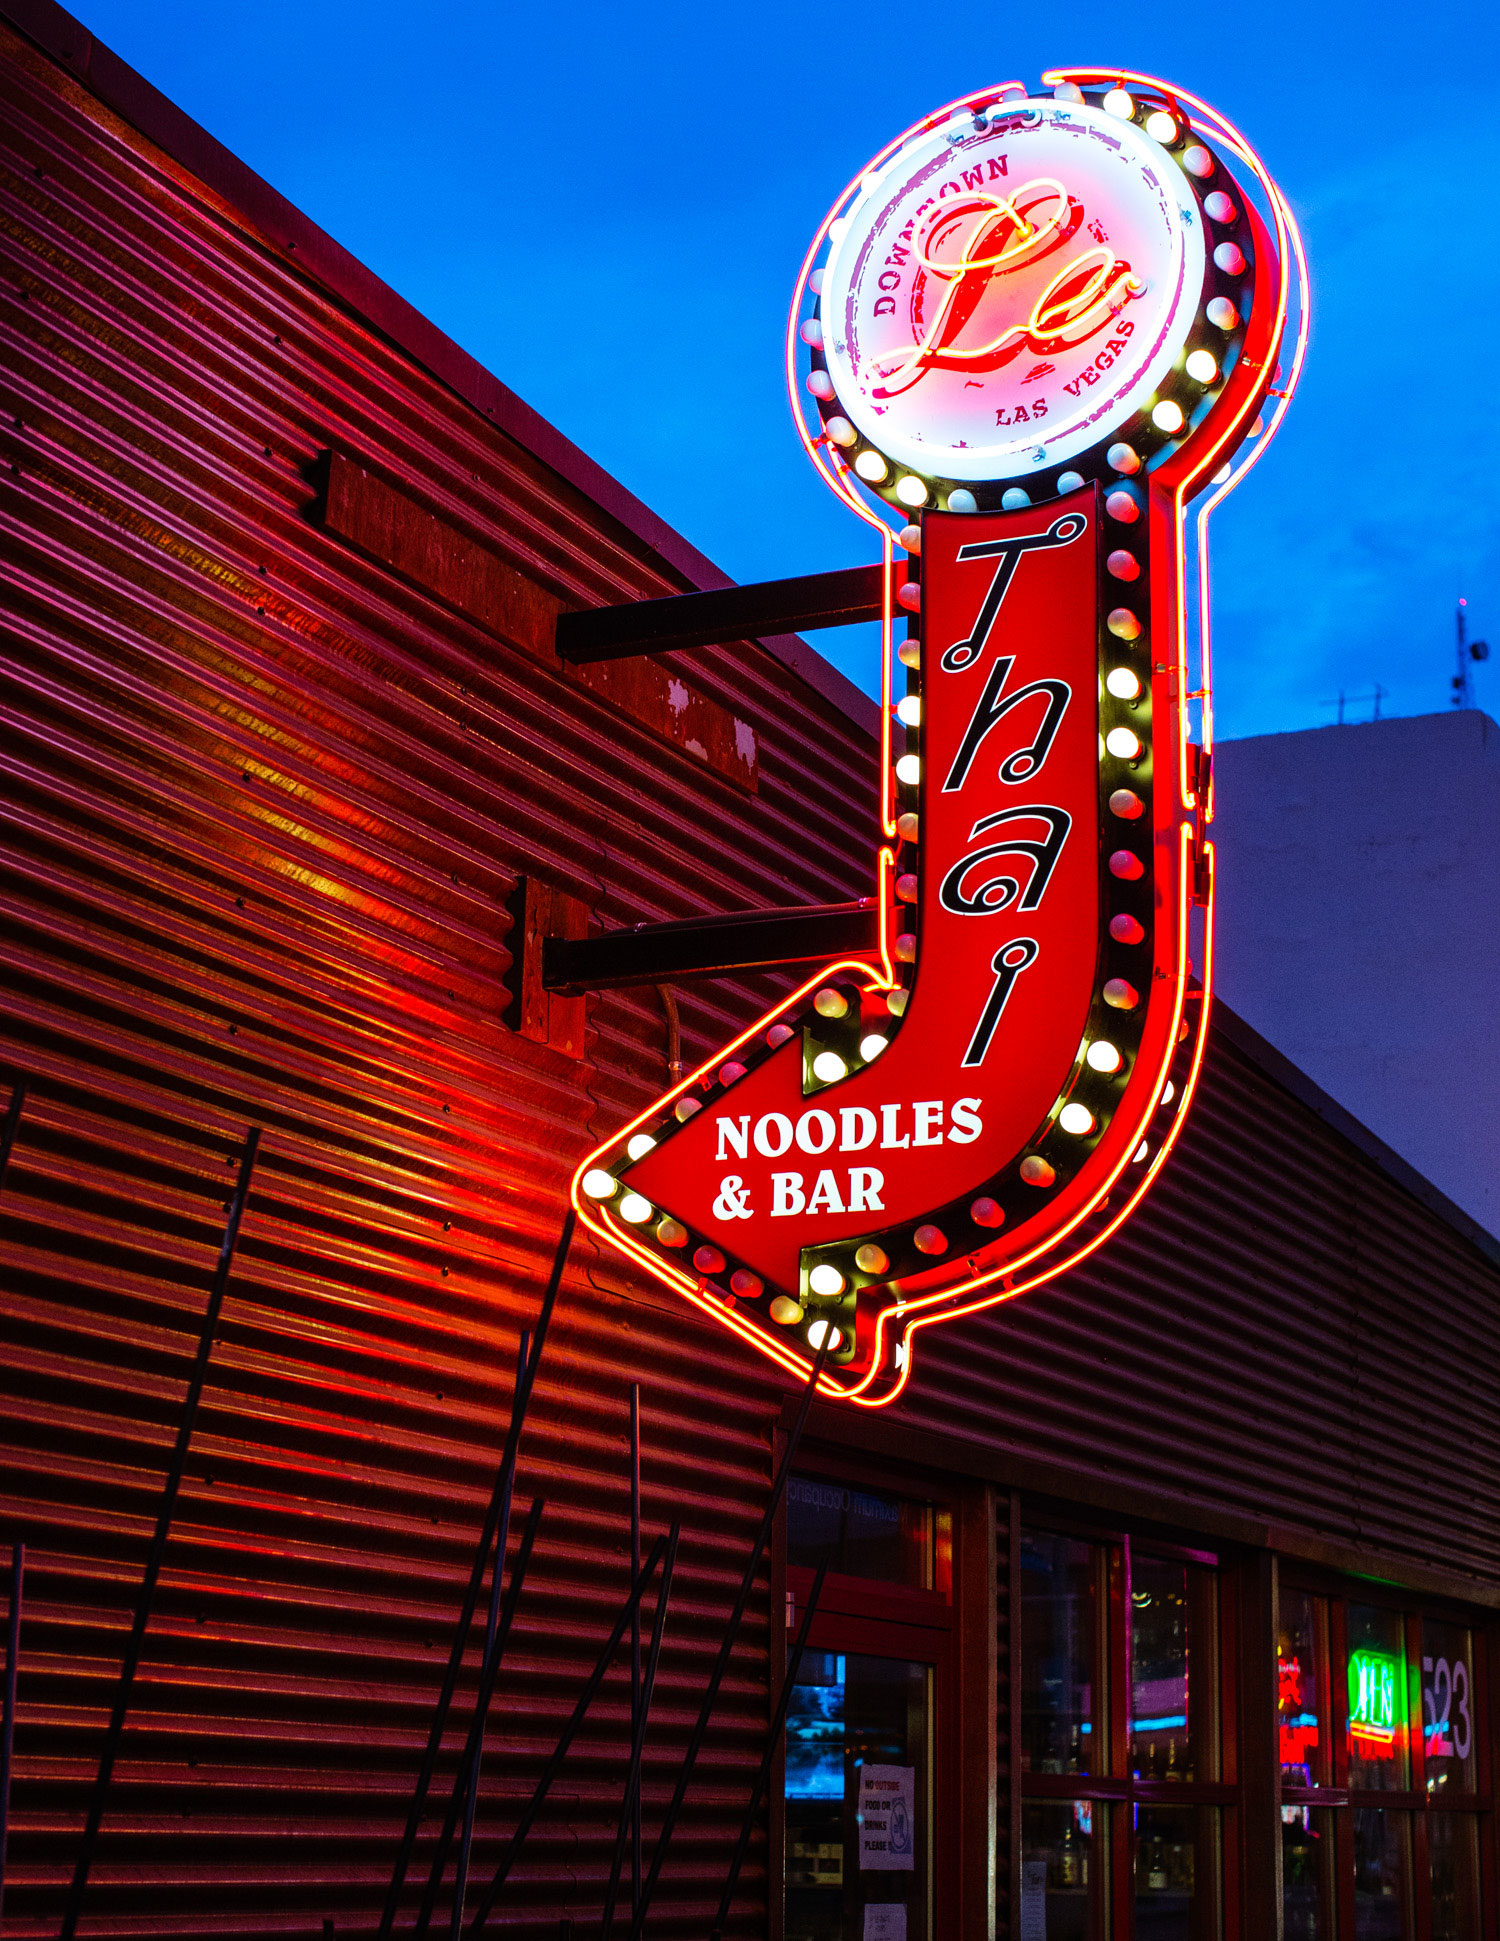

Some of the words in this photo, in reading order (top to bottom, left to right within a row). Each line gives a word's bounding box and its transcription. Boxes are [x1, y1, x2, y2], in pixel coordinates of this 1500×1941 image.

[865, 177, 1147, 398] Le
[996, 397, 1048, 426] LAS
[1063, 319, 1135, 397] VEGAS
[939, 512, 1088, 1067] Thai
[715, 1097, 984, 1161] NOODLES
[712, 1174, 754, 1220] &
[770, 1166, 886, 1218] BAR
[864, 1779, 874, 1790] NO
[875, 1780, 900, 1791] OUTSIDE
[865, 1800, 880, 1810] FOOD
[881, 1800, 891, 1810] OR
[864, 1820, 887, 1831] DRINKS
[864, 1840, 886, 1851] PLEASE
